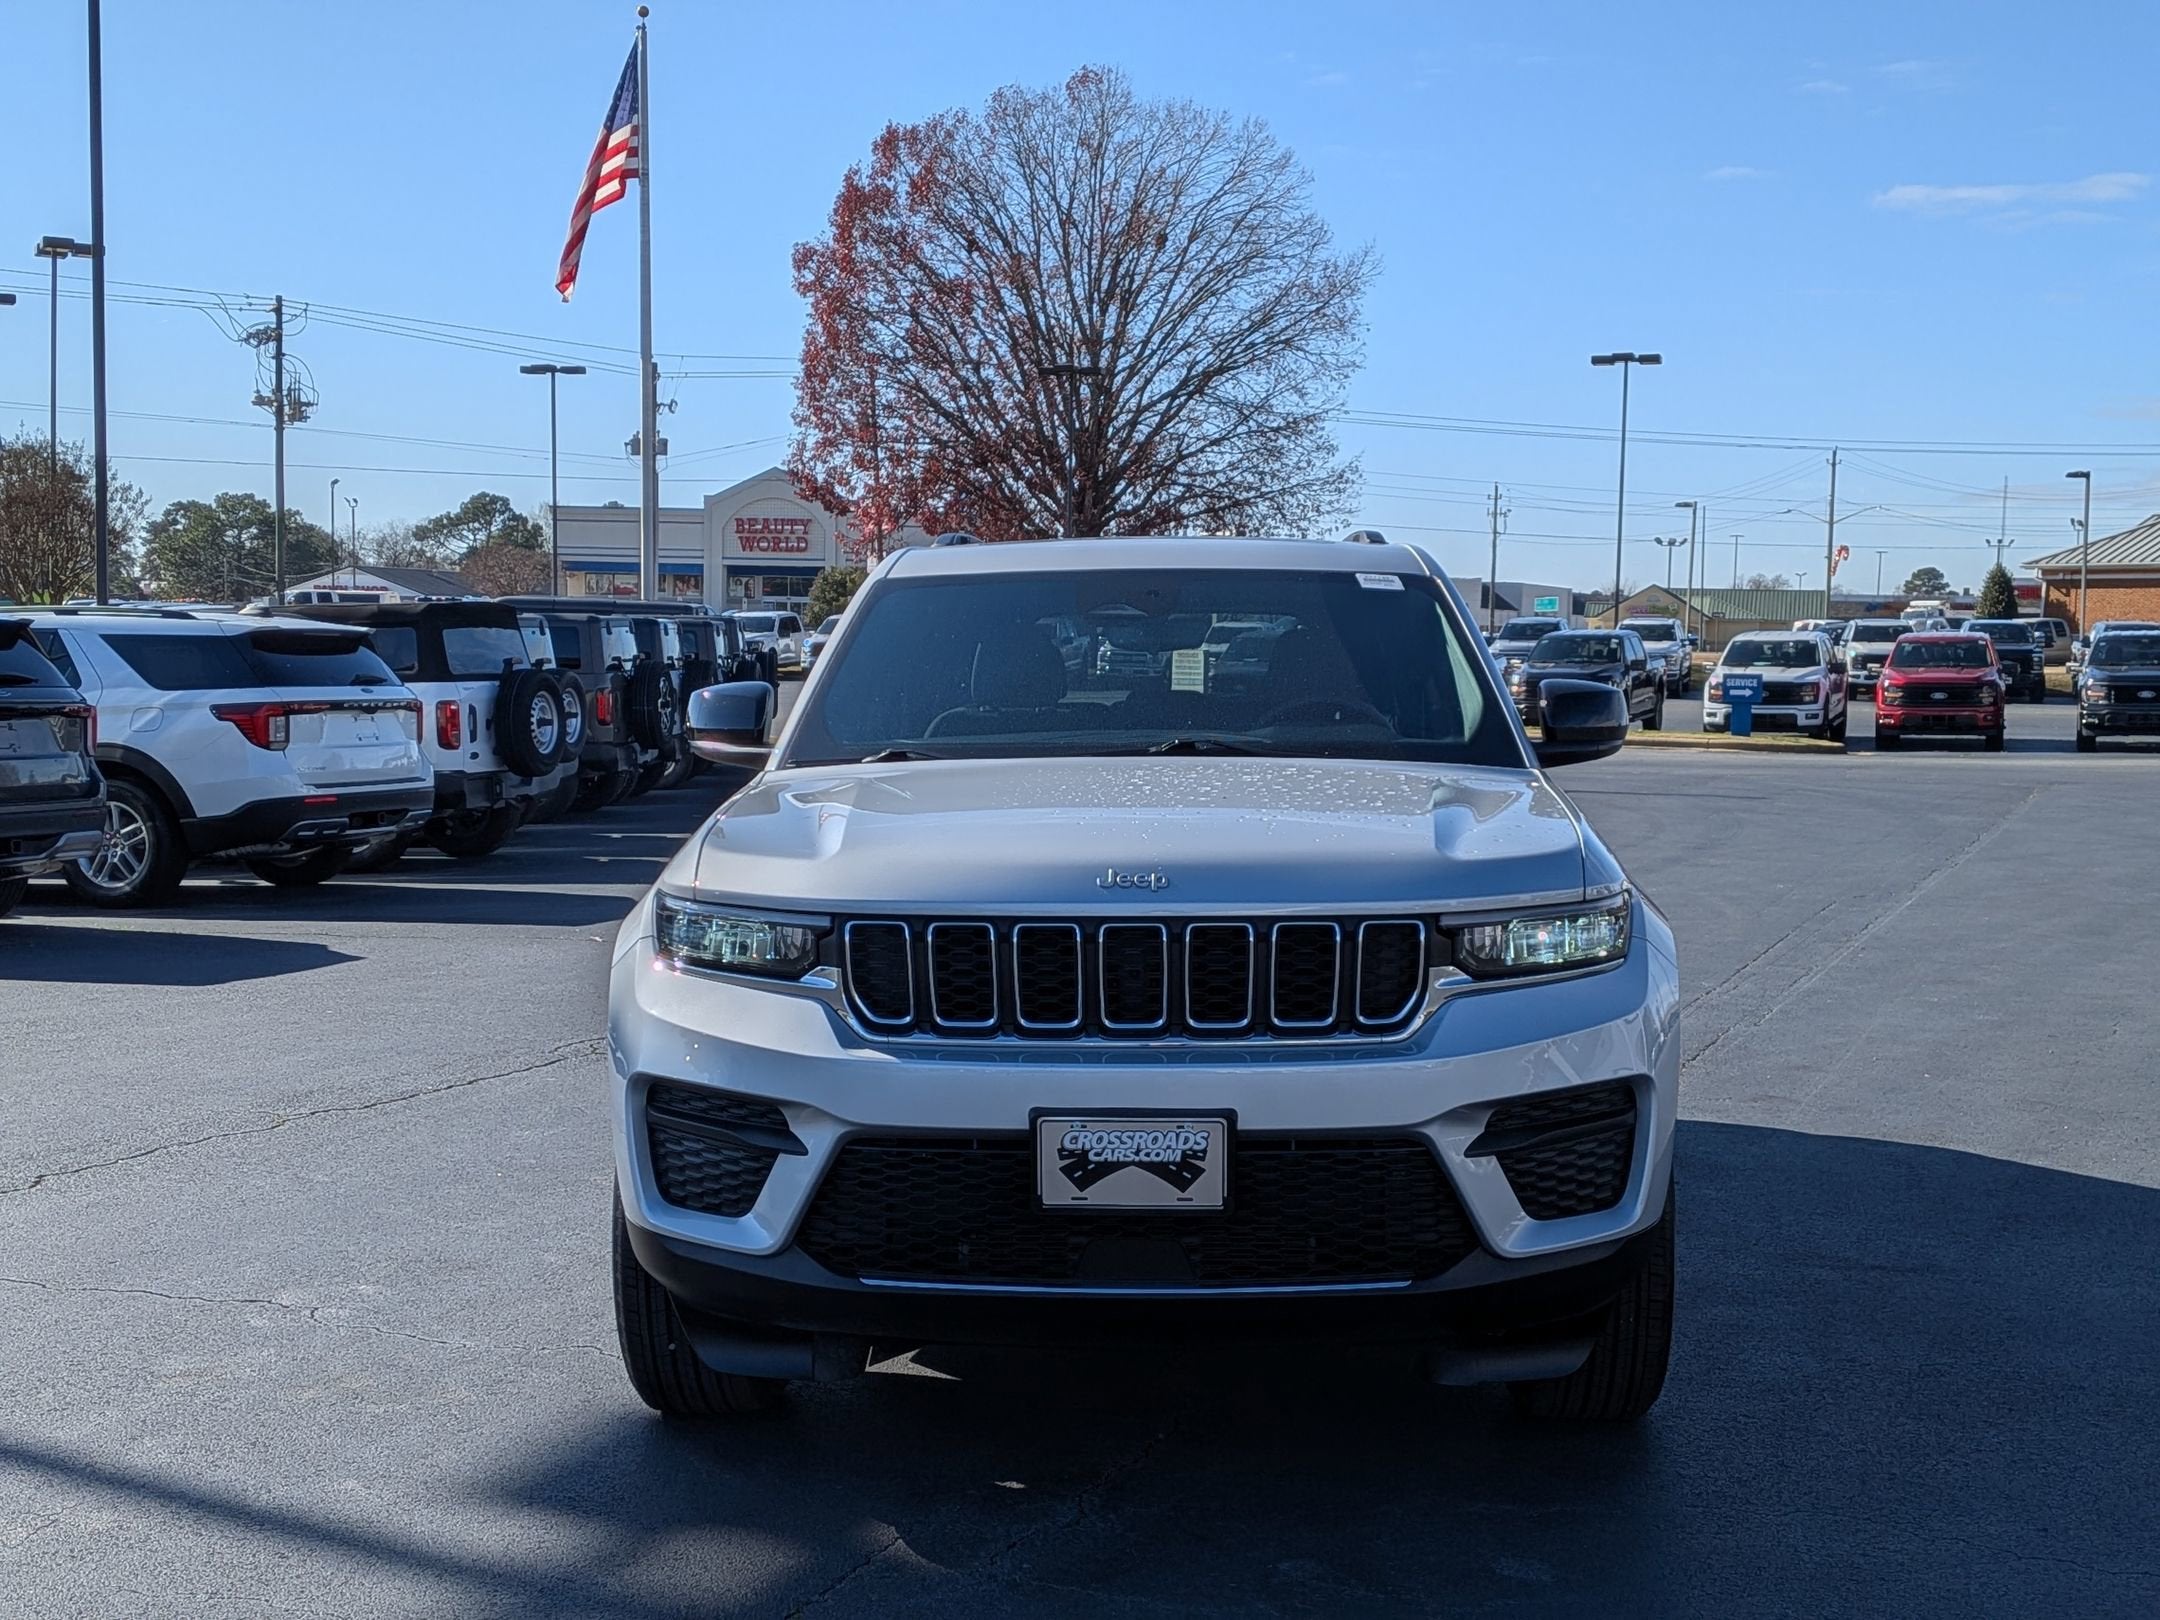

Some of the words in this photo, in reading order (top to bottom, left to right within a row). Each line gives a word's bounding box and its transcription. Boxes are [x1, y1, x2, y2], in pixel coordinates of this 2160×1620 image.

[734, 517, 812, 535] BEAUTY
[738, 535, 809, 553] WORLD
[1725, 677, 1758, 687] SERVICE
[1096, 867, 1169, 892] Jeep
[1061, 1129, 1210, 1151] CROSSROADS
[1087, 1148, 1183, 1163] CARS.COM
